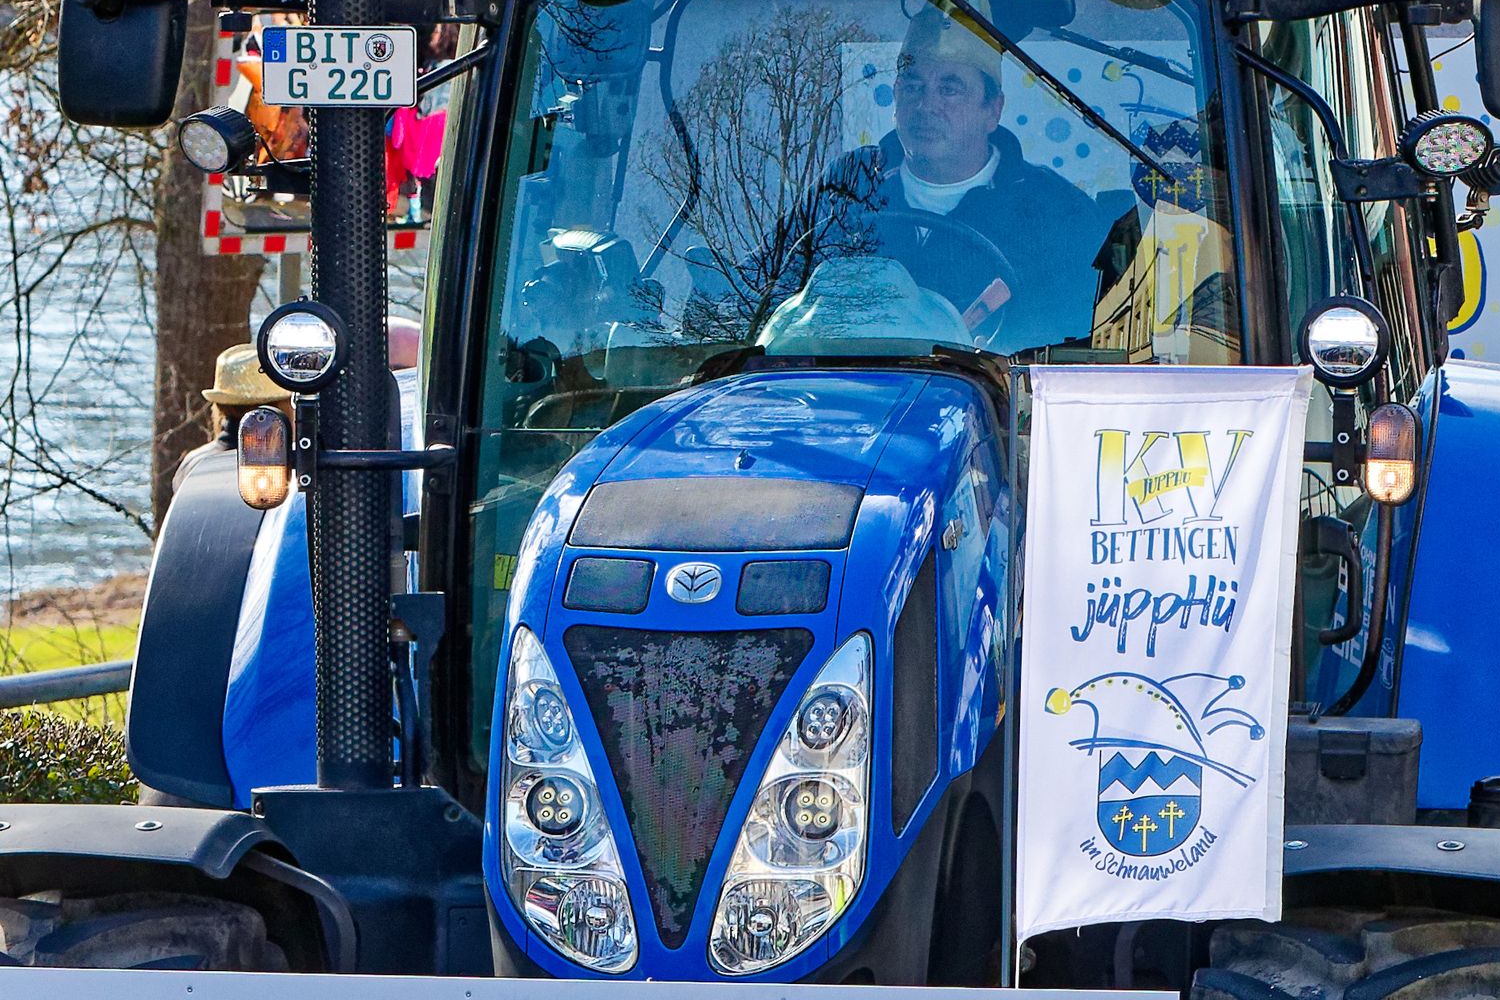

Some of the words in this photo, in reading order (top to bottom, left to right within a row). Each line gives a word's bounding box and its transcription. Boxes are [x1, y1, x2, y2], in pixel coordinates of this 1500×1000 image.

[271, 50, 280, 60] D
[296, 32, 360, 63] BIT
[288, 68, 308, 99] G
[328, 69, 392, 100] 220
[1090, 428, 1255, 527] KV
[1090, 525, 1240, 565] BETTINGEN
[1080, 836, 1103, 860] im
[1096, 825, 1219, 881] Schnauweland
